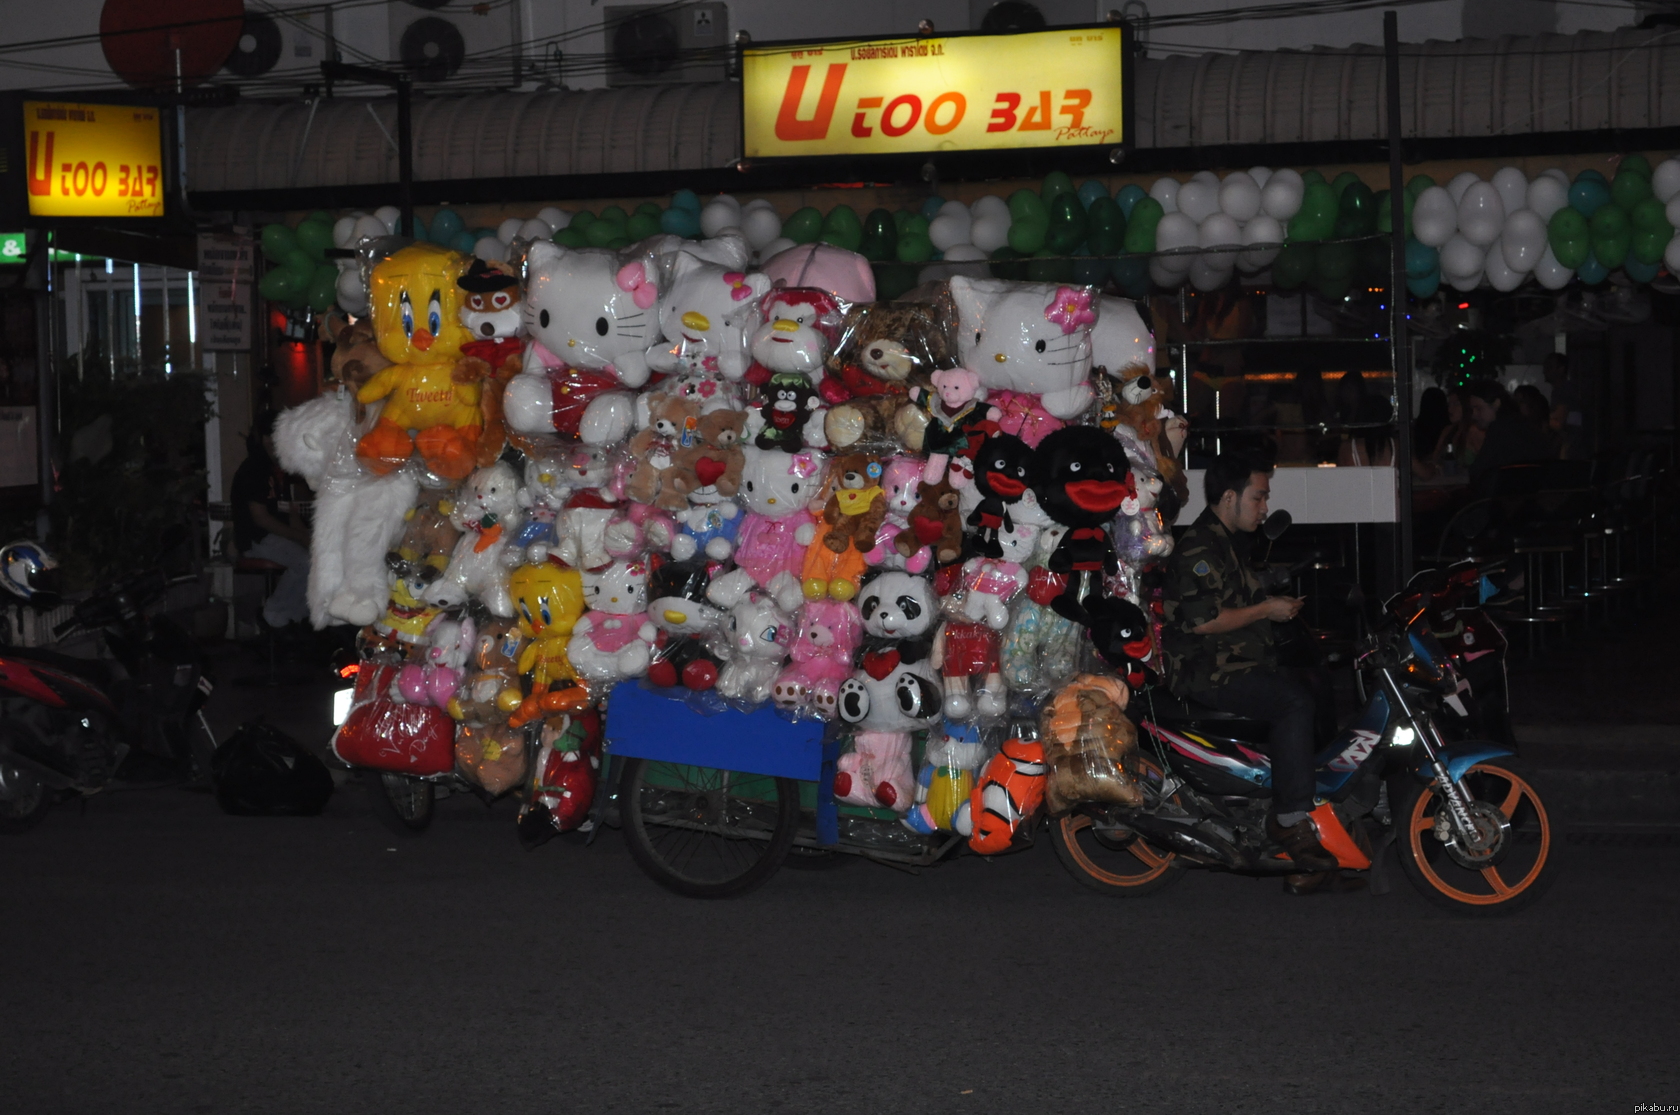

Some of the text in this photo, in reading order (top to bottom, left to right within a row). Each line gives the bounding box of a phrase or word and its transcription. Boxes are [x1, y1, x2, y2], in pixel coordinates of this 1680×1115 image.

[773, 63, 848, 142] U
[986, 89, 1093, 133] BAR
[1055, 125, 1115, 144] Pattaya
[28, 131, 55, 196] U
[118, 164, 159, 197] BAR
[406, 388, 453, 407] Tweety
